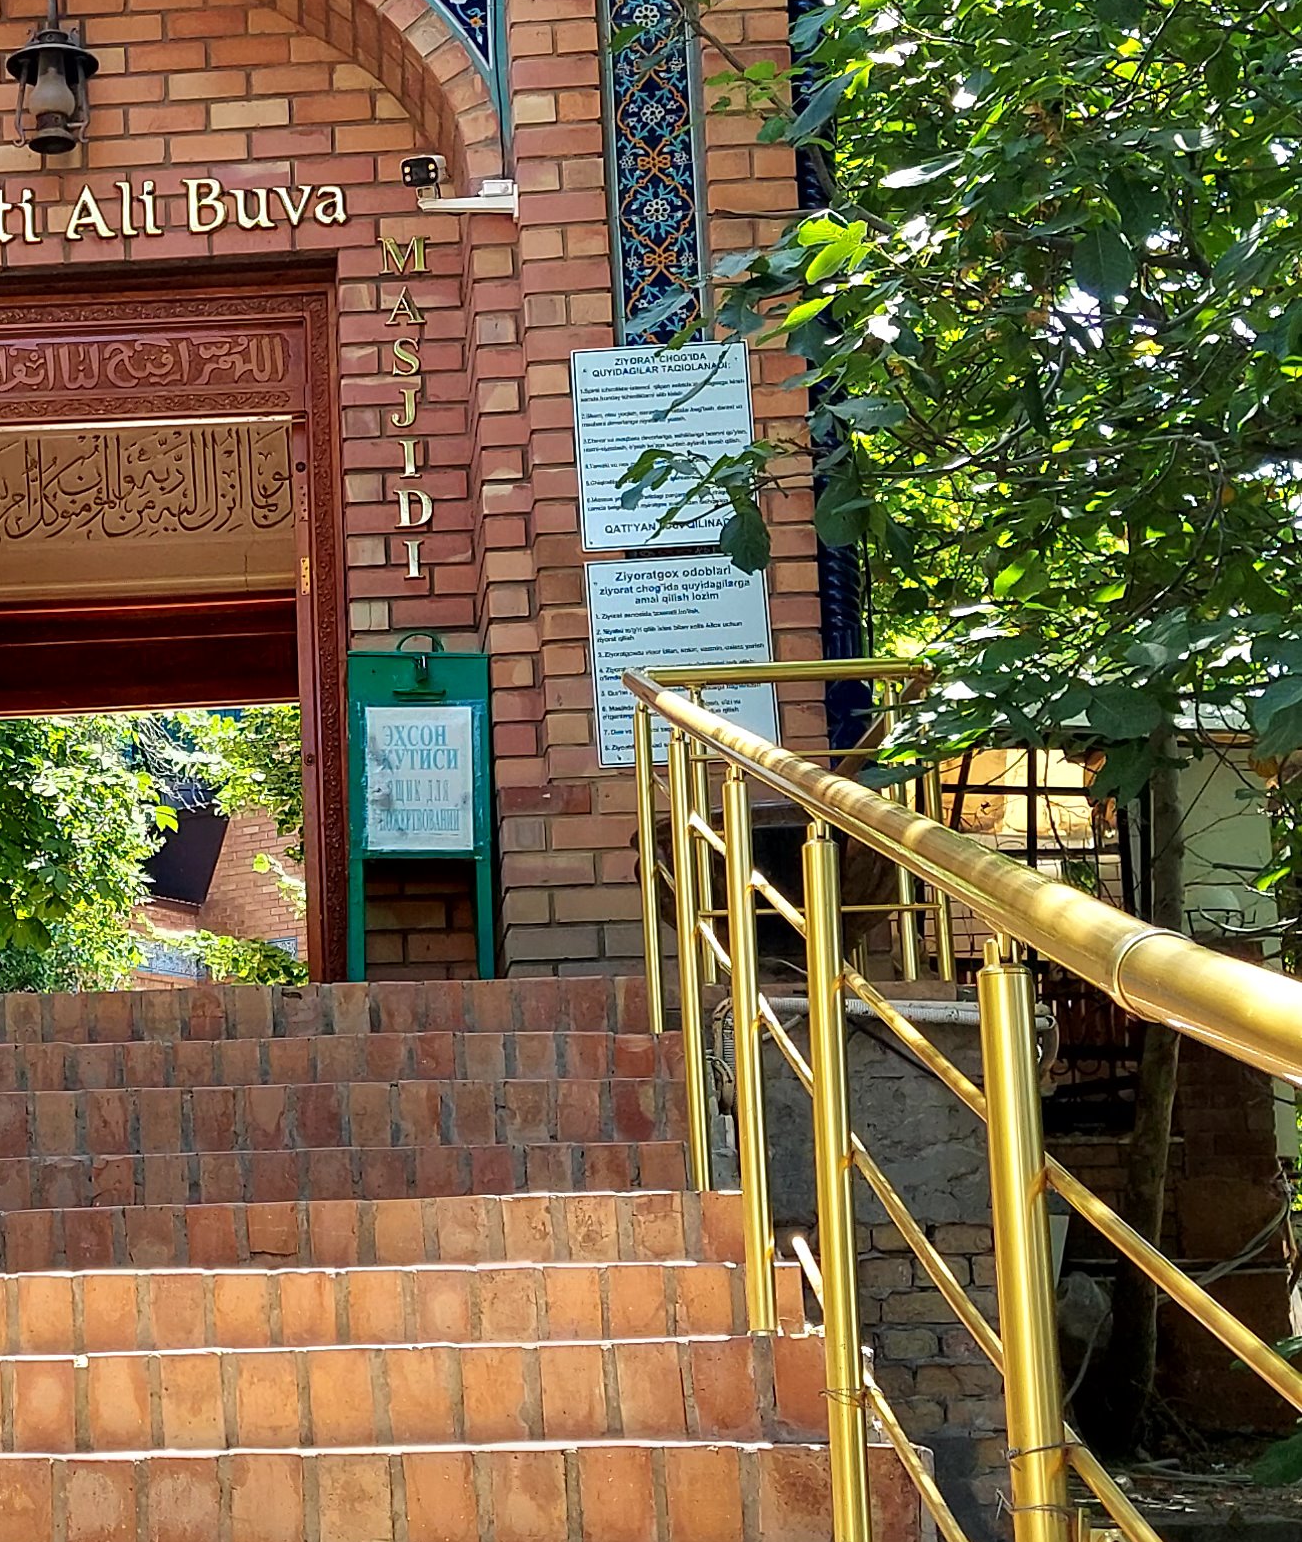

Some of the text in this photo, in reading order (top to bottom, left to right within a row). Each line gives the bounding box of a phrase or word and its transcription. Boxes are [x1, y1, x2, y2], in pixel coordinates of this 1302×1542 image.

[64, 178, 165, 241] Ali
[180, 176, 350, 235] Buva
[614, 355, 656, 366] ZIYORAT
[592, 365, 659, 378] QUYIDAGILAR
[376, 235, 434, 581] MASJIDI
[615, 565, 731, 584] Ziyoratgox odoblari
[599, 585, 634, 597] ziyorat
[681, 579, 750, 592] quyidagilarga
[635, 591, 719, 605] amal qilish lozim
[426, 779, 449, 805] ДЛЯ
